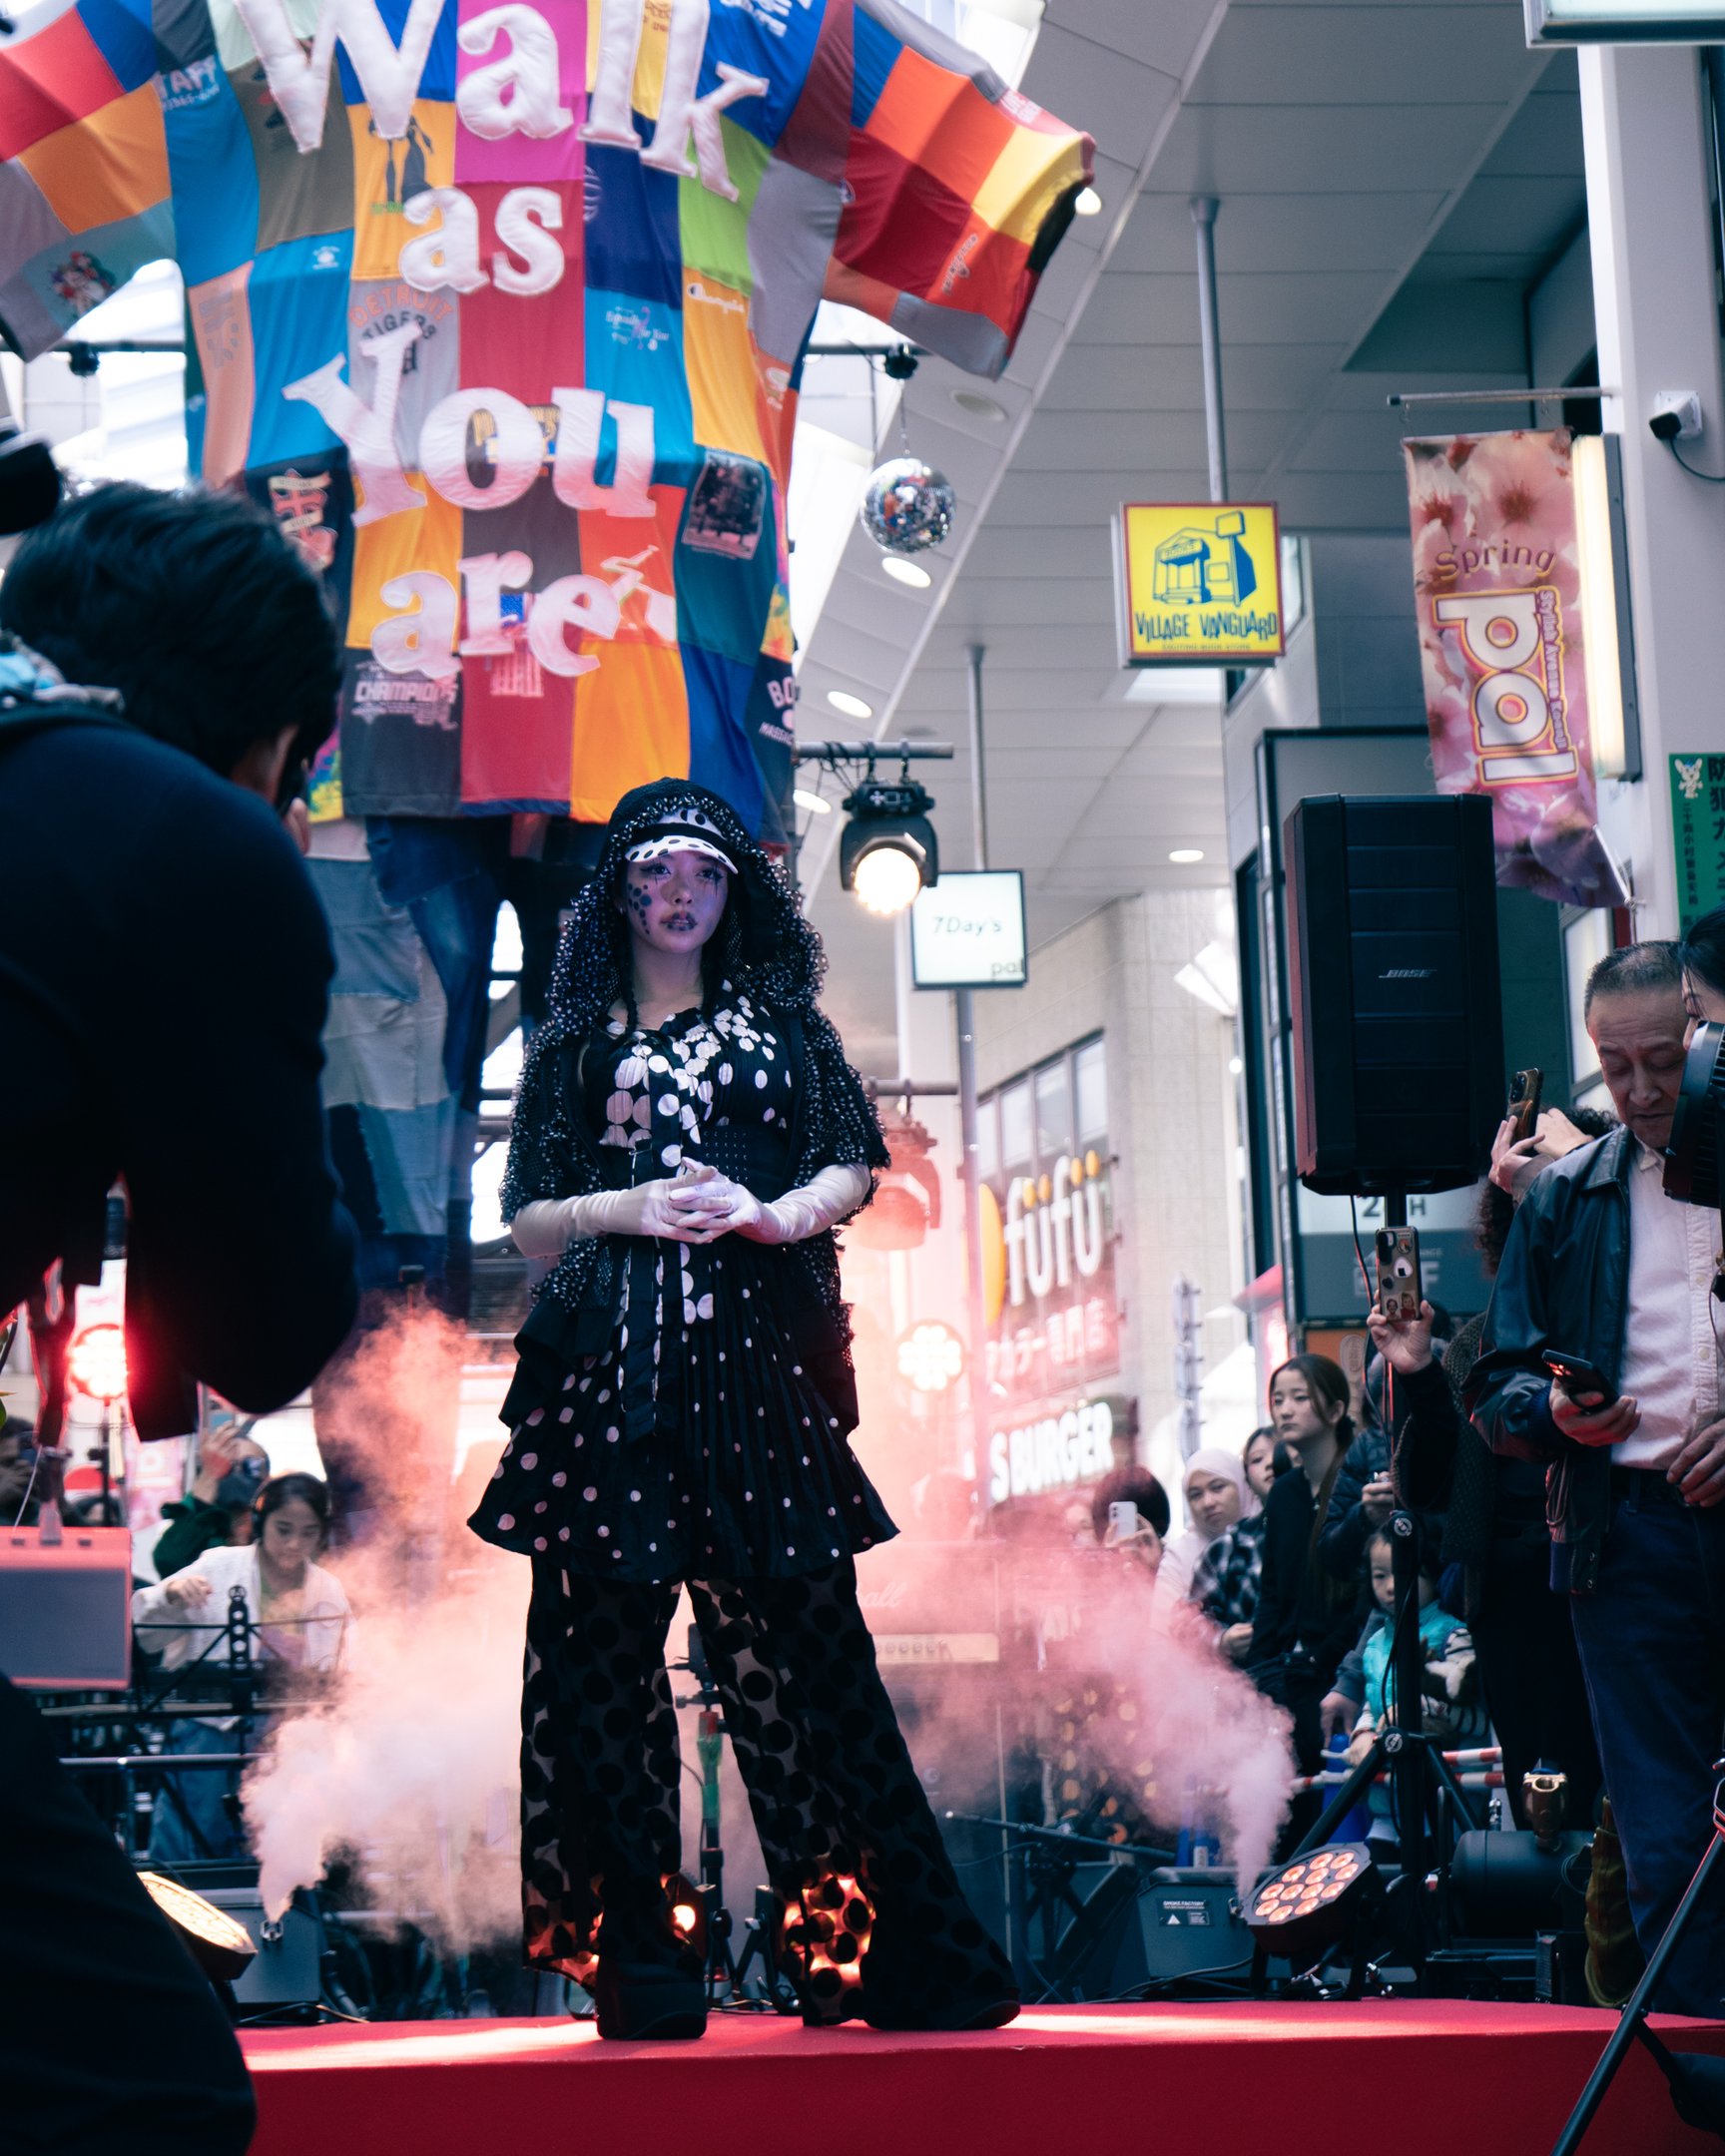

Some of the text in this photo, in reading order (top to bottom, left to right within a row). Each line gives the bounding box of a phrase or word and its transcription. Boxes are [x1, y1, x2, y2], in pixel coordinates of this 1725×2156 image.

[234, 0, 770, 203] Walk
[398, 186, 566, 296] as
[282, 319, 657, 528] You
[369, 550, 622, 678] are
[1435, 541, 1558, 582] Spring
[1135, 610, 1277, 644] VILLAGE VANGUARD
[1436, 592, 1579, 784] pal
[1379, 969, 1438, 978] BOSE
